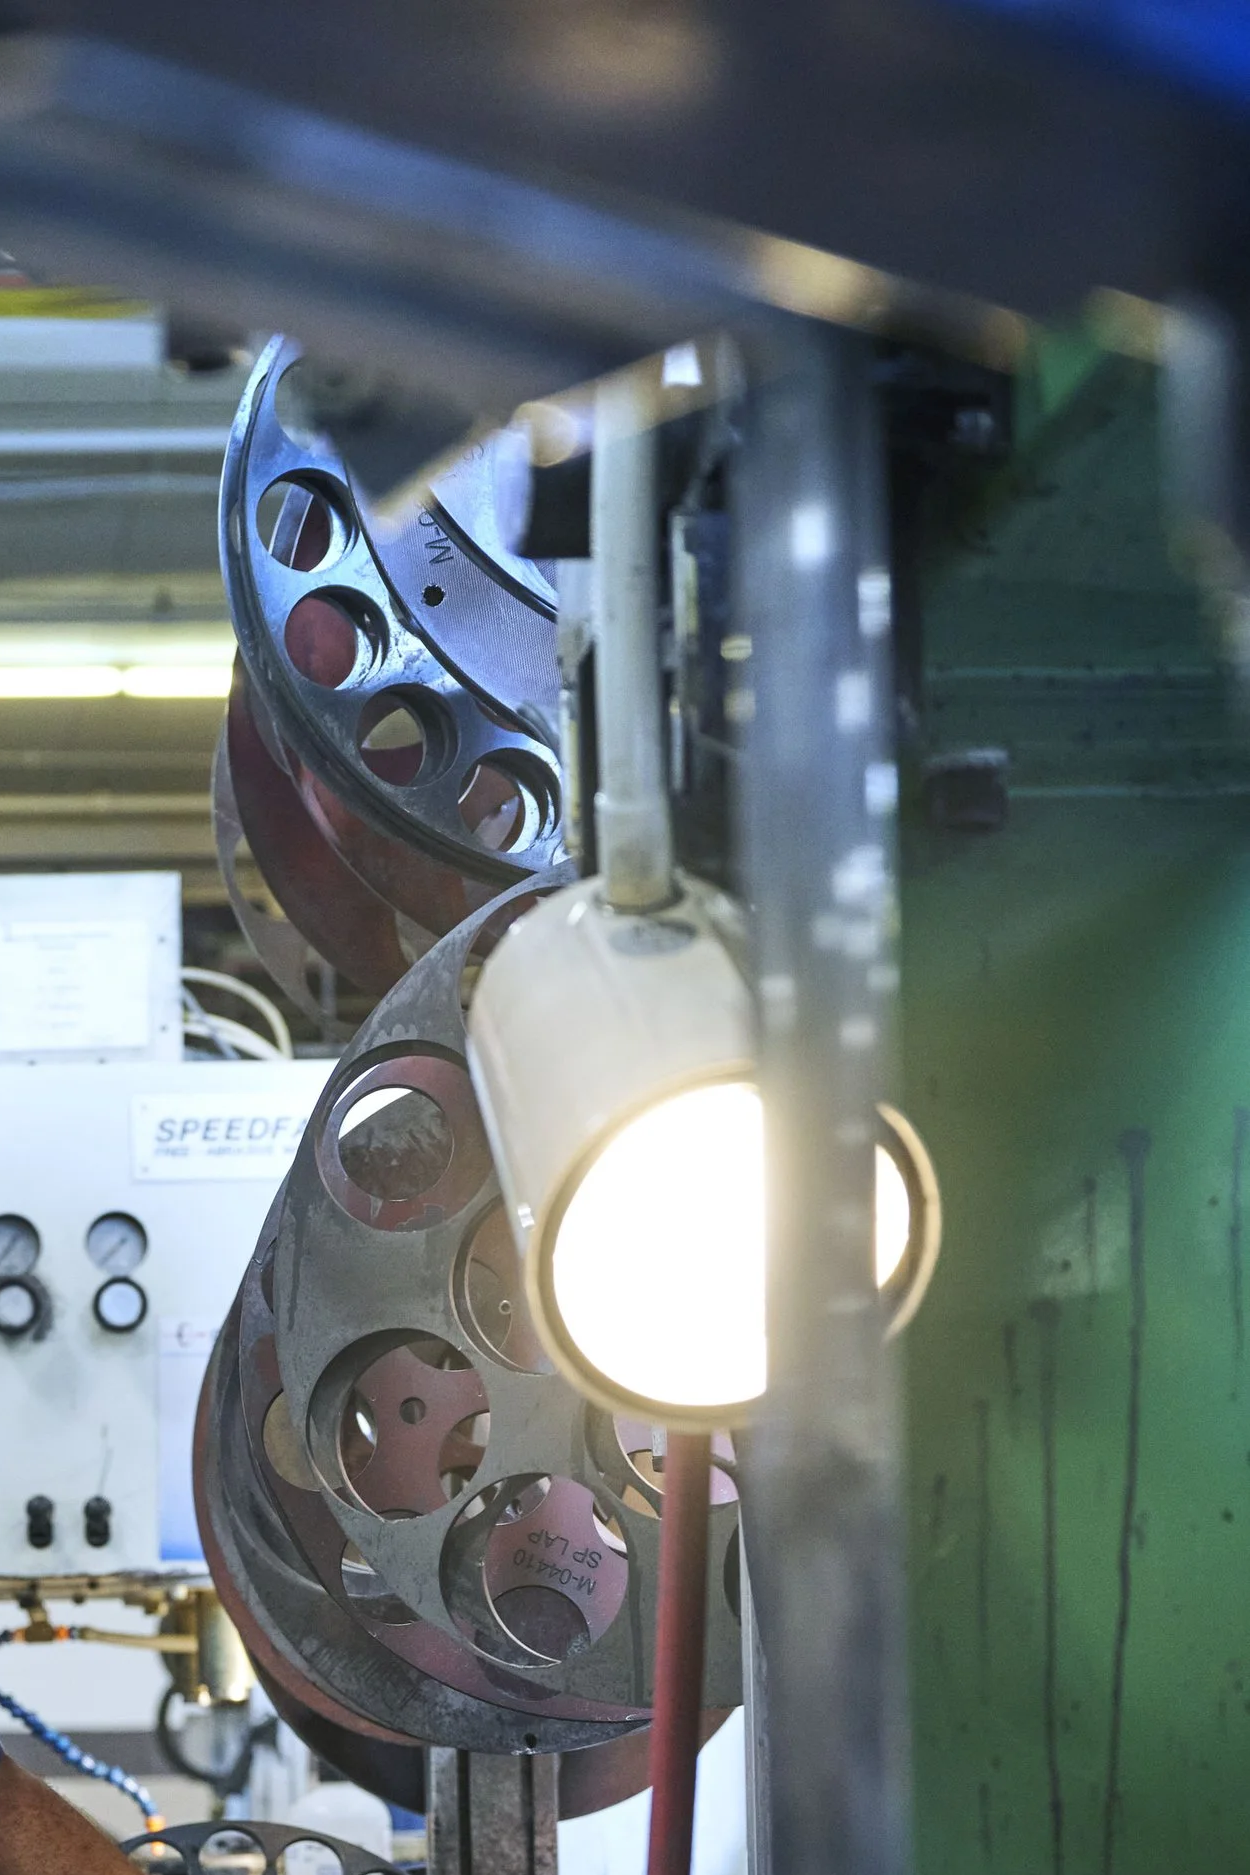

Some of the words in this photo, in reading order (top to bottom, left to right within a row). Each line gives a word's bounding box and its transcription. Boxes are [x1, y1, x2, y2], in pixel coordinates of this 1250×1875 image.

[527, 1528, 570, 1556] LAP
[572, 1547, 602, 1569] SP
[513, 1549, 597, 1596] M-04410
